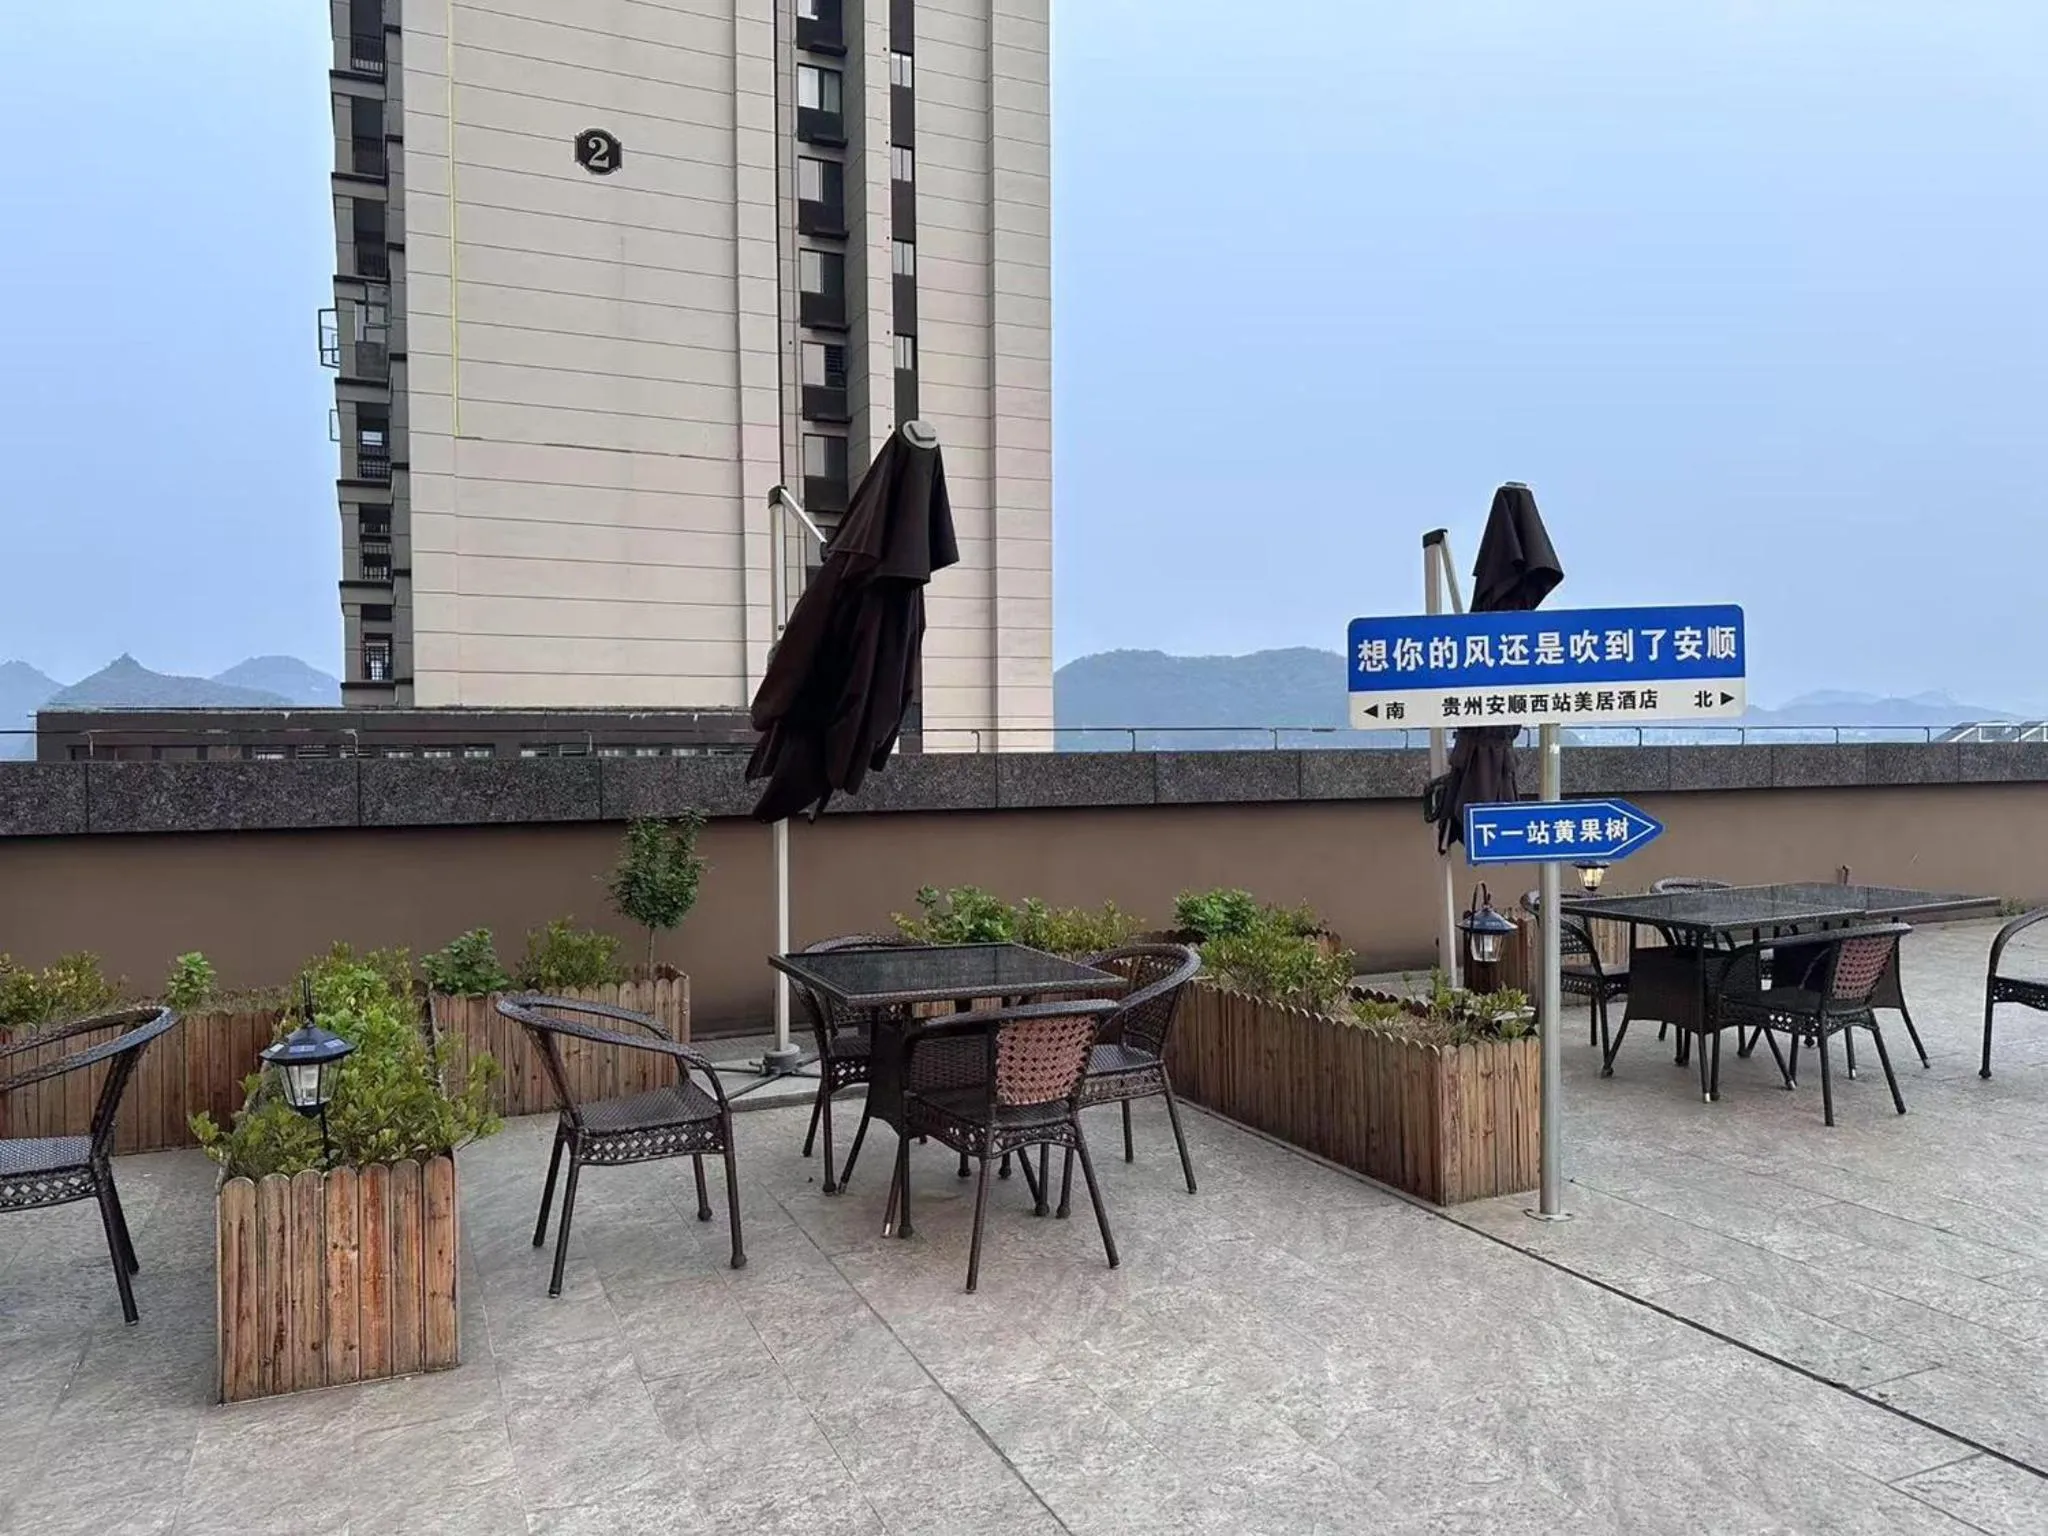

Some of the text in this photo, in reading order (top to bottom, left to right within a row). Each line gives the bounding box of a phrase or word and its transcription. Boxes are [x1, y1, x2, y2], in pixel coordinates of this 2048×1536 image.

[588, 137, 609, 168] 2
[1358, 626, 1737, 672] 想你的风还是吹到了安顺
[1386, 689, 1712, 719] 南 贵州安顺西站美居酒店 北
[1475, 817, 1629, 847] 下一站黄果树
